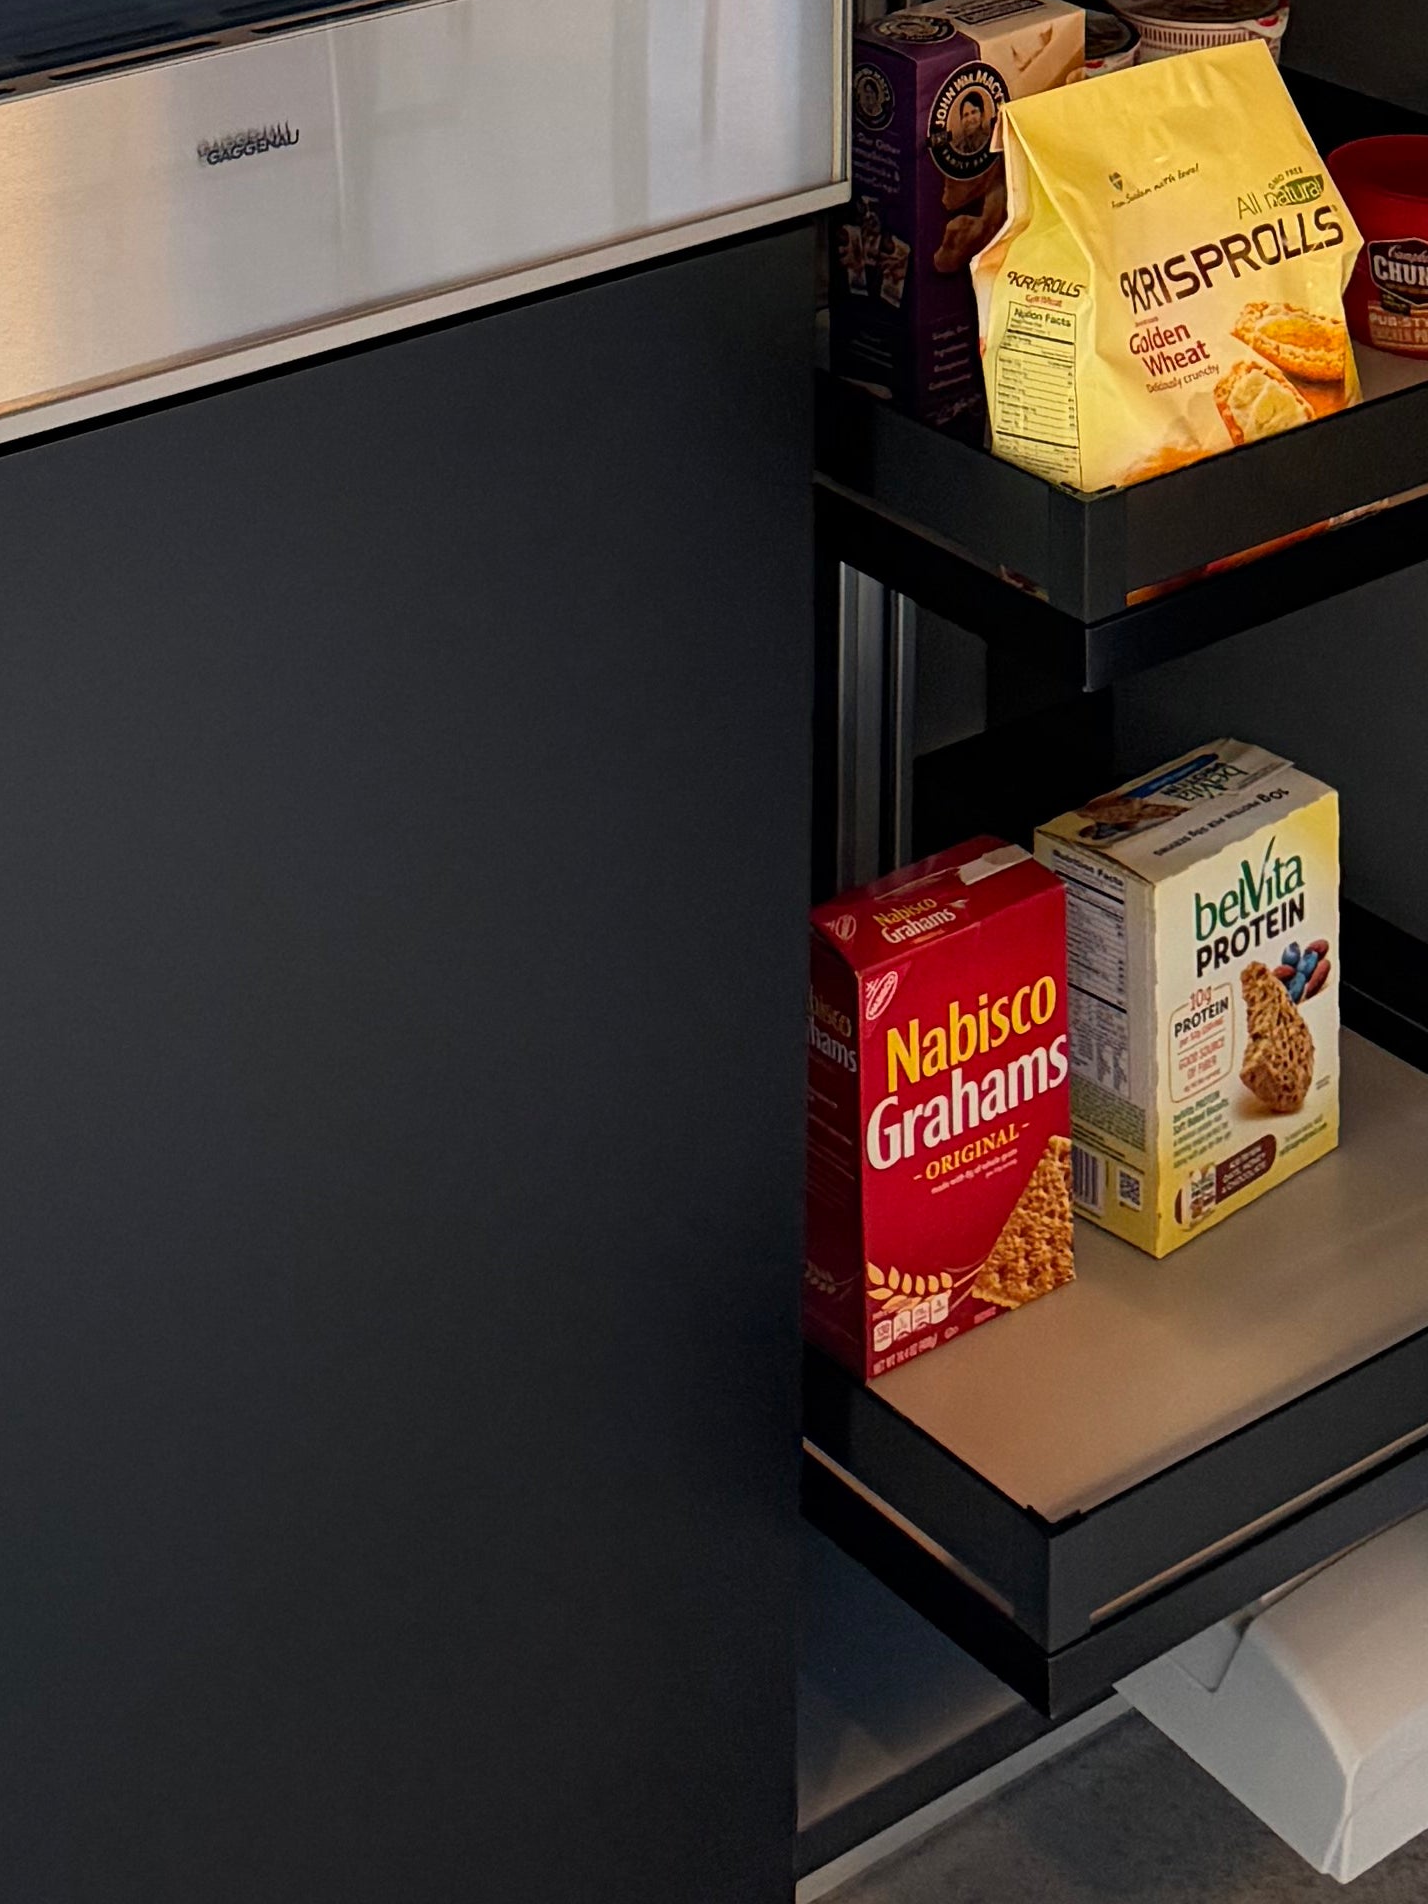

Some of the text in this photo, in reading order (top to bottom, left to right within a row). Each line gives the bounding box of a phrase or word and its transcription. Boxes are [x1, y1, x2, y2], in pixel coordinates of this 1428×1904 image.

[935, 86, 956, 128] JOHN
[206, 129, 300, 166] GAGGENAU
[1238, 176, 1322, 220] All natural
[1120, 205, 1344, 314] KRISPROLLS
[1130, 324, 1191, 355] Golden
[1142, 340, 1210, 378] Wheat
[1258, 787, 1290, 803] 10g
[1194, 836, 1306, 942] belVita
[872, 898, 938, 927] Nabisco
[881, 908, 956, 944] Grahams
[1196, 892, 1305, 978] PROTEIN
[1174, 996, 1229, 1038] PROTEIN
[1189, 986, 1212, 1011] 10g
[809, 1015, 858, 1072] hams
[887, 976, 1056, 1093] Nabisco
[866, 1034, 1068, 1170] Grahams
[925, 1123, 1020, 1180] ORIGINAL
